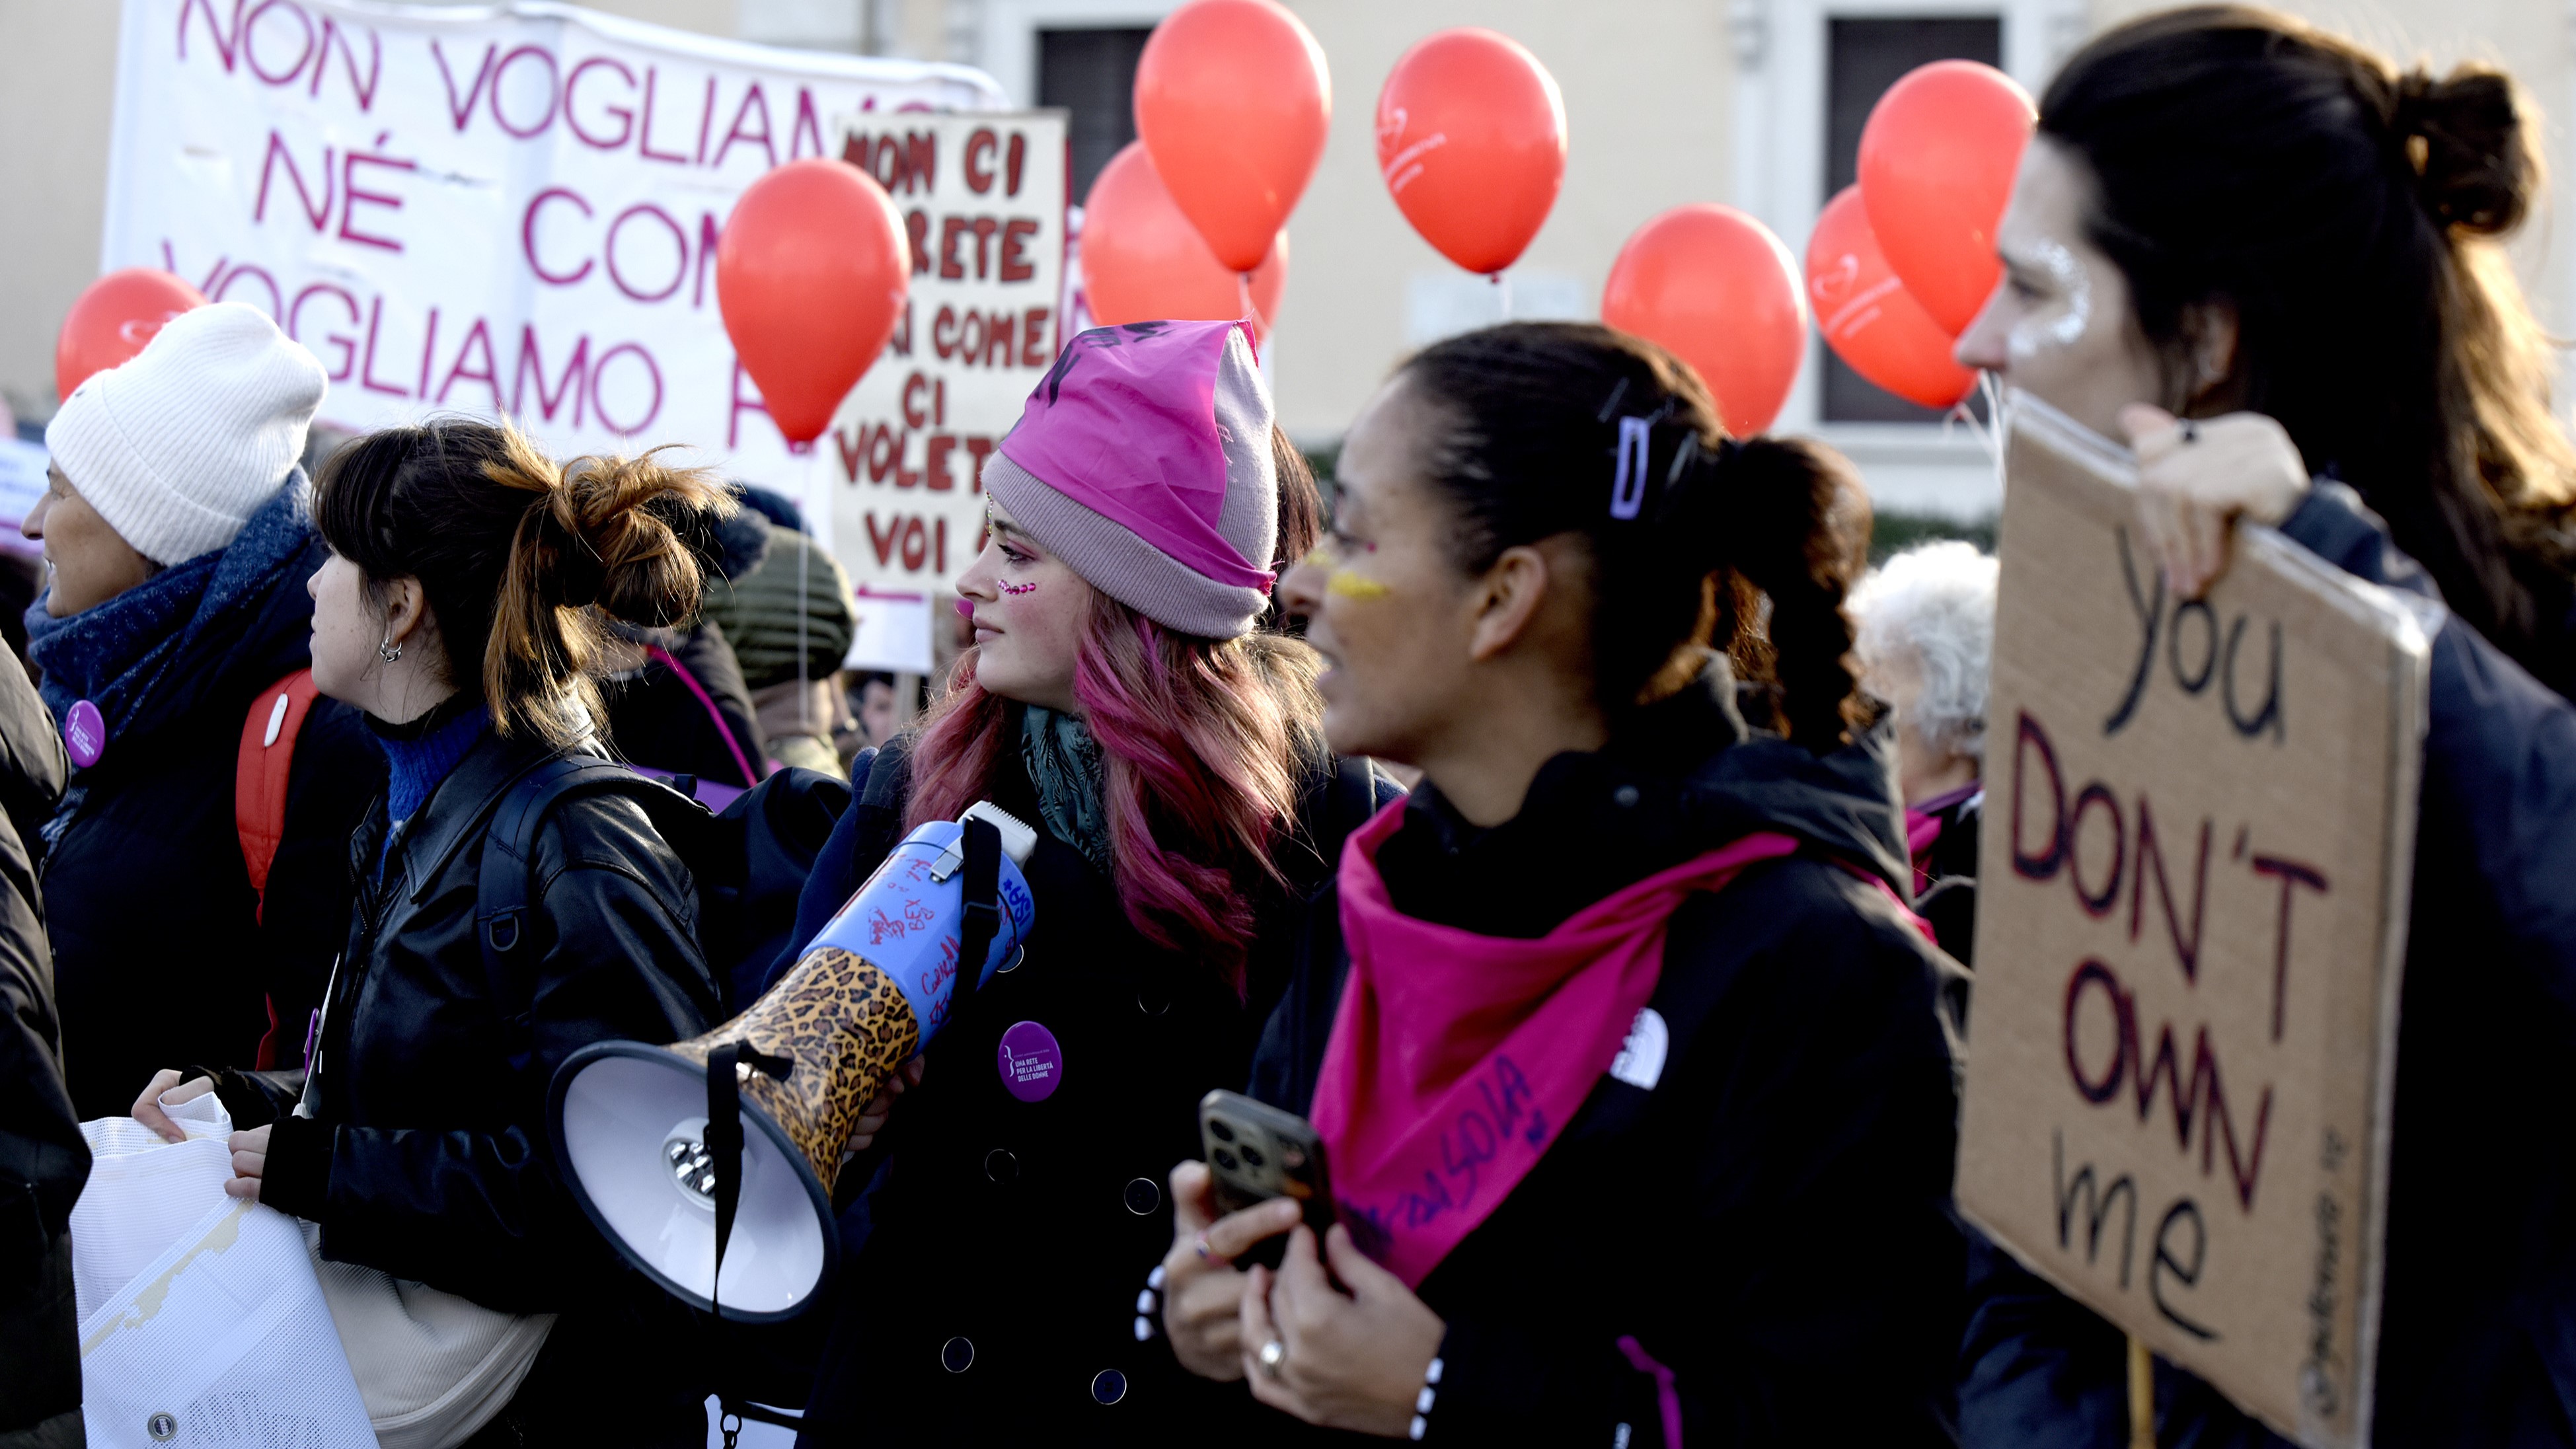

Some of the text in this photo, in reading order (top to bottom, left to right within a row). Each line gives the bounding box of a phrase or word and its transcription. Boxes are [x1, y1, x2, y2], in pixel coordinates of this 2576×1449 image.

[177, 0, 932, 169] NON VOGLIAM
[254, 131, 416, 253] NÉ
[964, 127, 1026, 196] CI
[932, 304, 1049, 368] COME
[901, 372, 944, 429] CI
[837, 423, 1003, 497] VOLET
[866, 511, 945, 574] VOI
[2011, 704, 2330, 1044] DON'T
[1018, 1071, 1049, 1082] DELLE DONNE
[2063, 954, 2273, 1217] OWN
